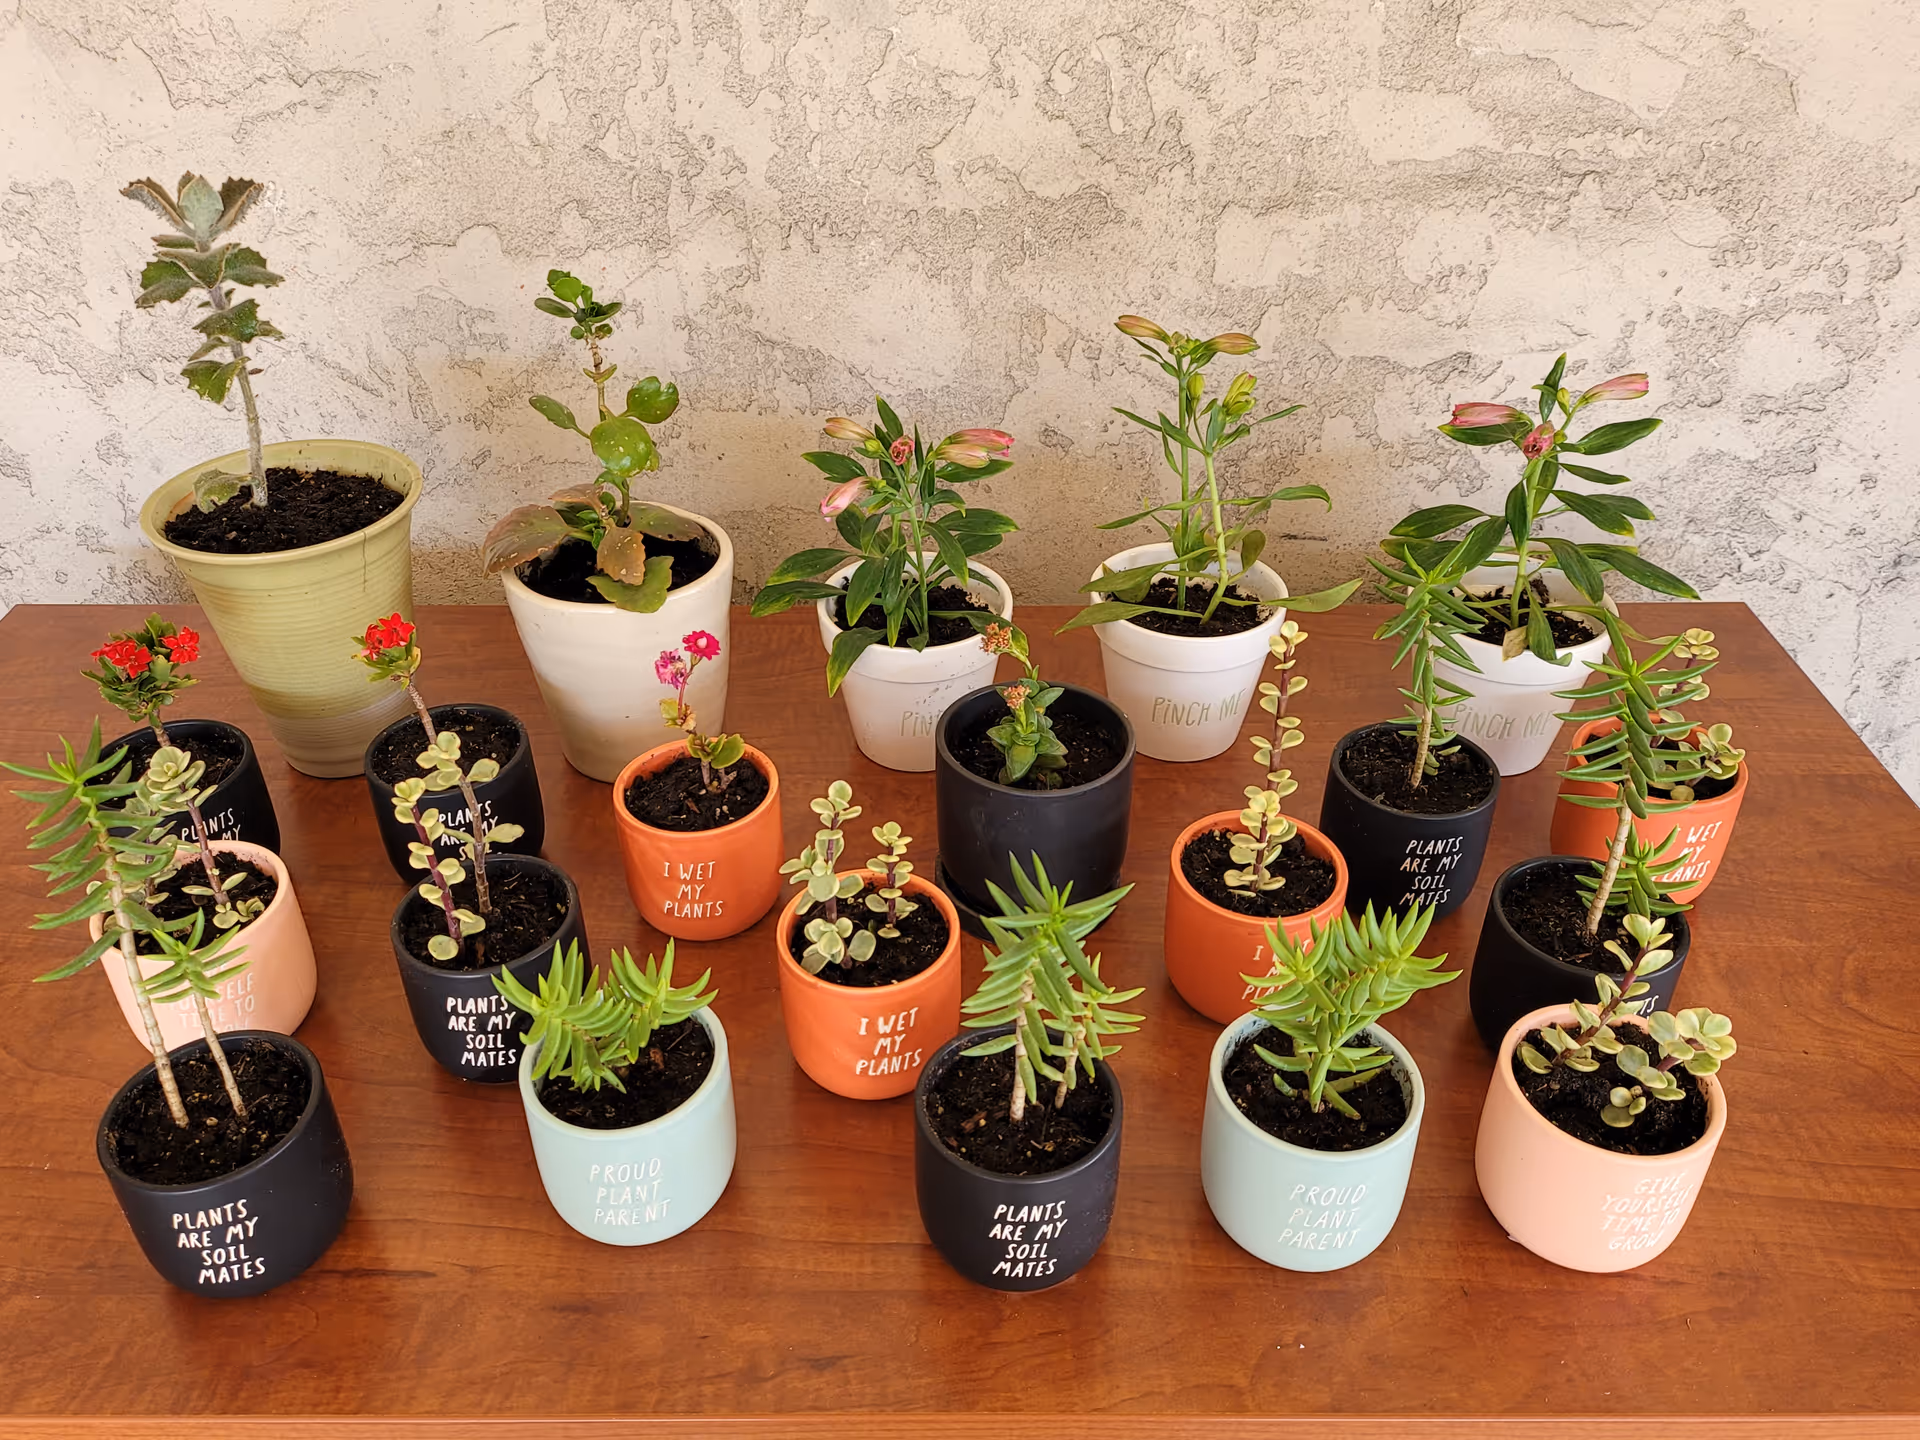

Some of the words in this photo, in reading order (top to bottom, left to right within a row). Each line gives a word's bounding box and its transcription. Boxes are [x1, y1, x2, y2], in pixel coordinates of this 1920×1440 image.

[1218, 687, 1247, 722] ME
[901, 710, 938, 737] PiN
[1523, 708, 1557, 738] ME
[1686, 820, 1723, 844] WET
[1405, 836, 1464, 855] PLANTS
[663, 861, 671, 878] I
[679, 860, 716, 881] WET
[1399, 856, 1431, 873] ARE
[1435, 853, 1463, 873] MY
[1651, 859, 1711, 882] LANTS
[677, 883, 706, 901] MY
[1411, 873, 1446, 890] SOIL
[1398, 888, 1451, 906] MATES
[663, 899, 724, 919] PLANTS
[1252, 945, 1265, 961] I
[234, 994, 255, 1017] TO
[446, 994, 509, 1015] PLANTS
[447, 1014, 477, 1032] ARE
[487, 1011, 517, 1032] MY
[858, 1017, 870, 1036] I
[877, 1006, 919, 1035] WET
[465, 1033, 505, 1050] SOIL
[873, 1033, 907, 1056] MY
[460, 1048, 517, 1067] MATES
[855, 1048, 923, 1076] PLANTS
[589, 1157, 661, 1184] PROUD
[596, 1179, 662, 1205] PLANT
[1634, 1170, 1688, 1195] GIVE
[1289, 1183, 1367, 1207] PROUD
[172, 1198, 248, 1230] PLANTS
[594, 1198, 671, 1226] PARENT
[993, 1200, 1066, 1223] PLANTS
[1288, 1206, 1361, 1229] PLANT
[1601, 1213, 1658, 1233] TIME
[1660, 1206, 1681, 1231] TO
[177, 1230, 213, 1249] ARE
[225, 1215, 259, 1244] MY
[988, 1222, 1026, 1241] ARE
[1034, 1218, 1068, 1241] MY
[1277, 1227, 1361, 1251] PARENT
[1608, 1228, 1665, 1251] GROW
[201, 1243, 250, 1266] SOIL
[1005, 1242, 1048, 1260] SOIL
[198, 1257, 266, 1285] MATES
[992, 1258, 1058, 1278] MATES
